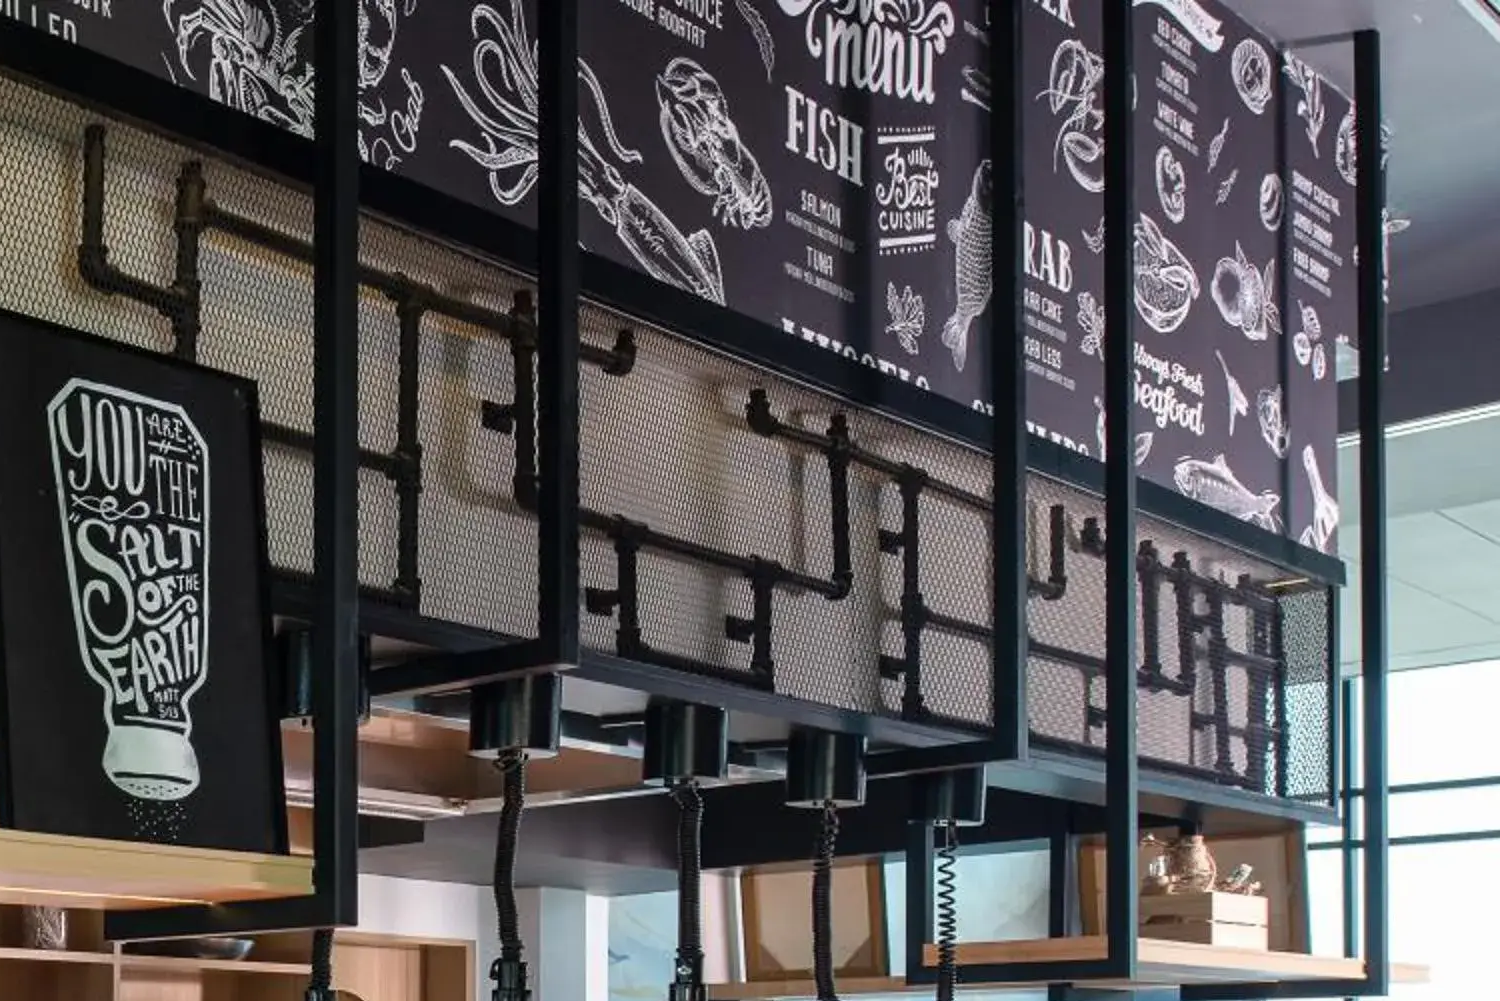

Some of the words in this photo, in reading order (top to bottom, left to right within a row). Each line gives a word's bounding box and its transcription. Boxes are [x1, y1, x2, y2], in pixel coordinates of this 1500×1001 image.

[824, 12, 937, 104] menu
[785, 84, 864, 187] FISH
[801, 188, 842, 229] SALMON
[876, 146, 939, 210] Best
[879, 207, 936, 232] CUISINE
[806, 244, 834, 279] TUNA
[1023, 219, 1073, 293] RAB
[145, 412, 188, 444] ARE
[149, 453, 201, 523] THE
[75, 517, 202, 645] SALT
[136, 575, 178, 614] OF
[176, 572, 201, 593] THE
[91, 608, 200, 714] EARTH
[153, 687, 181, 704] MATT
